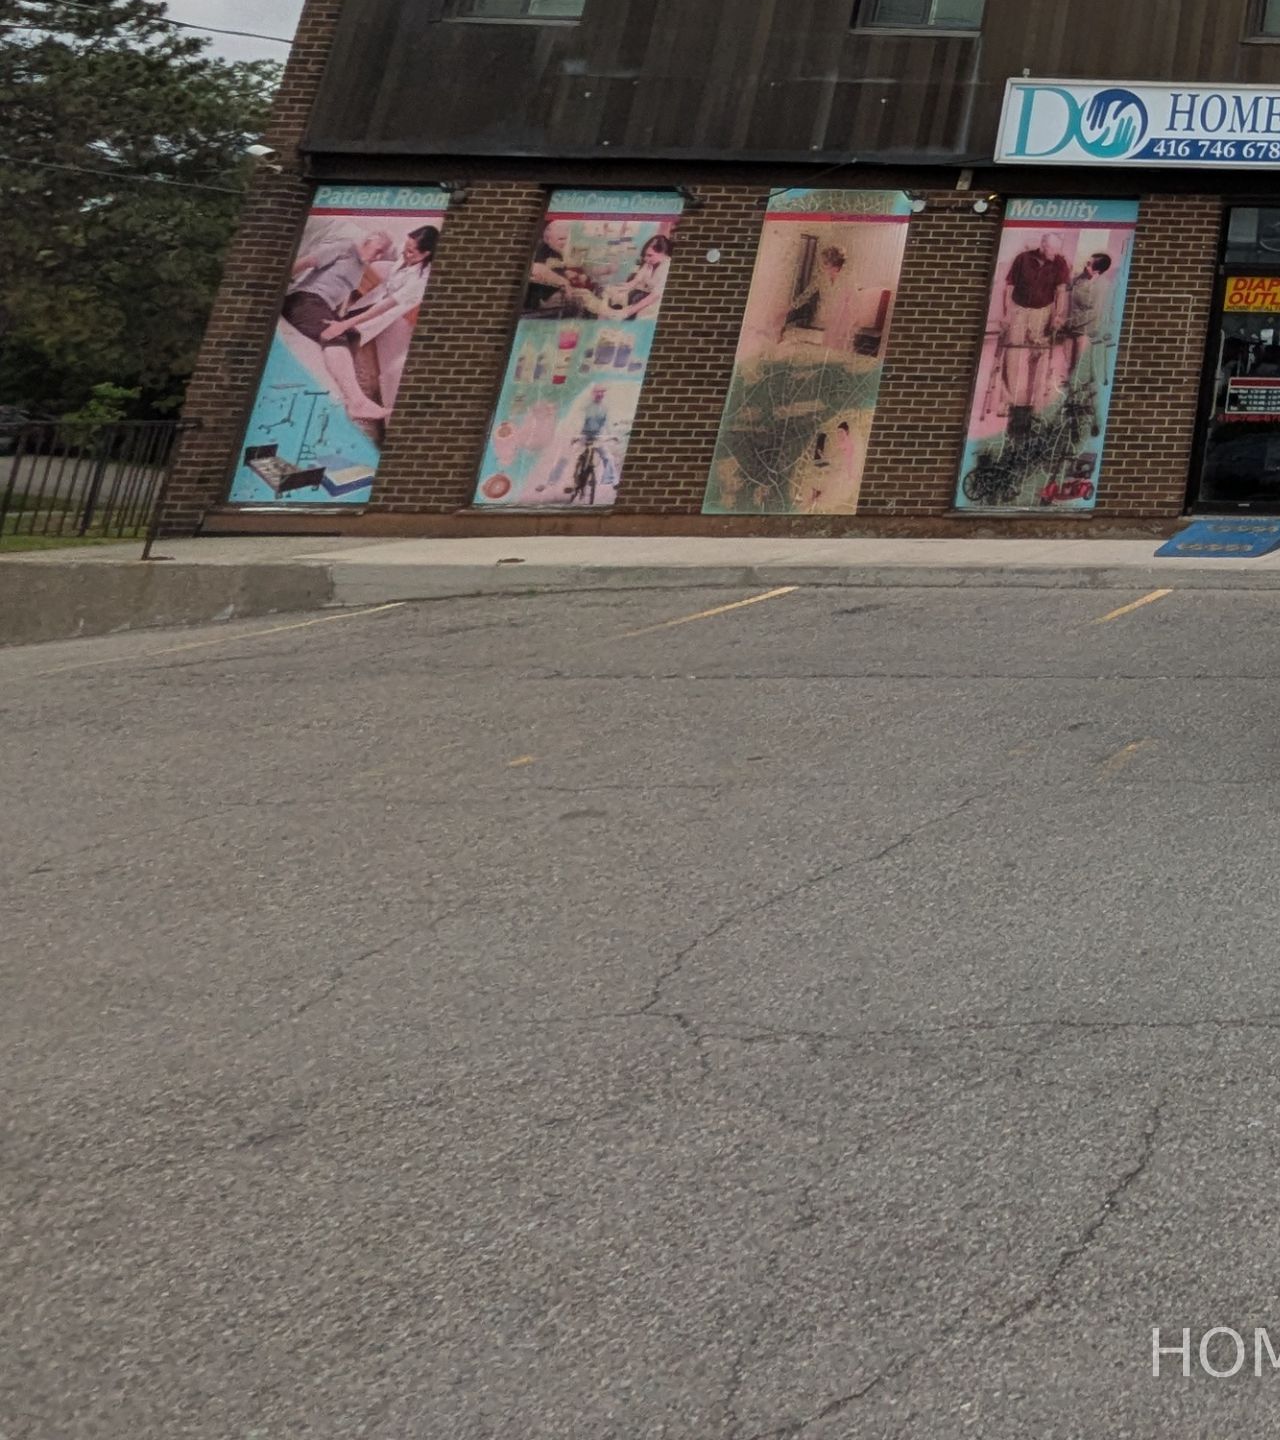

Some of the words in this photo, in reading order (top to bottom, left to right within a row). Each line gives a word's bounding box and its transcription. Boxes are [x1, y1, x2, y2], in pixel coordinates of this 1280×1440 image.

[1153, 139, 1190, 157] 416
[1198, 140, 1236, 158] 746
[315, 187, 389, 206] Patient
[1010, 200, 1098, 221] Mobility
